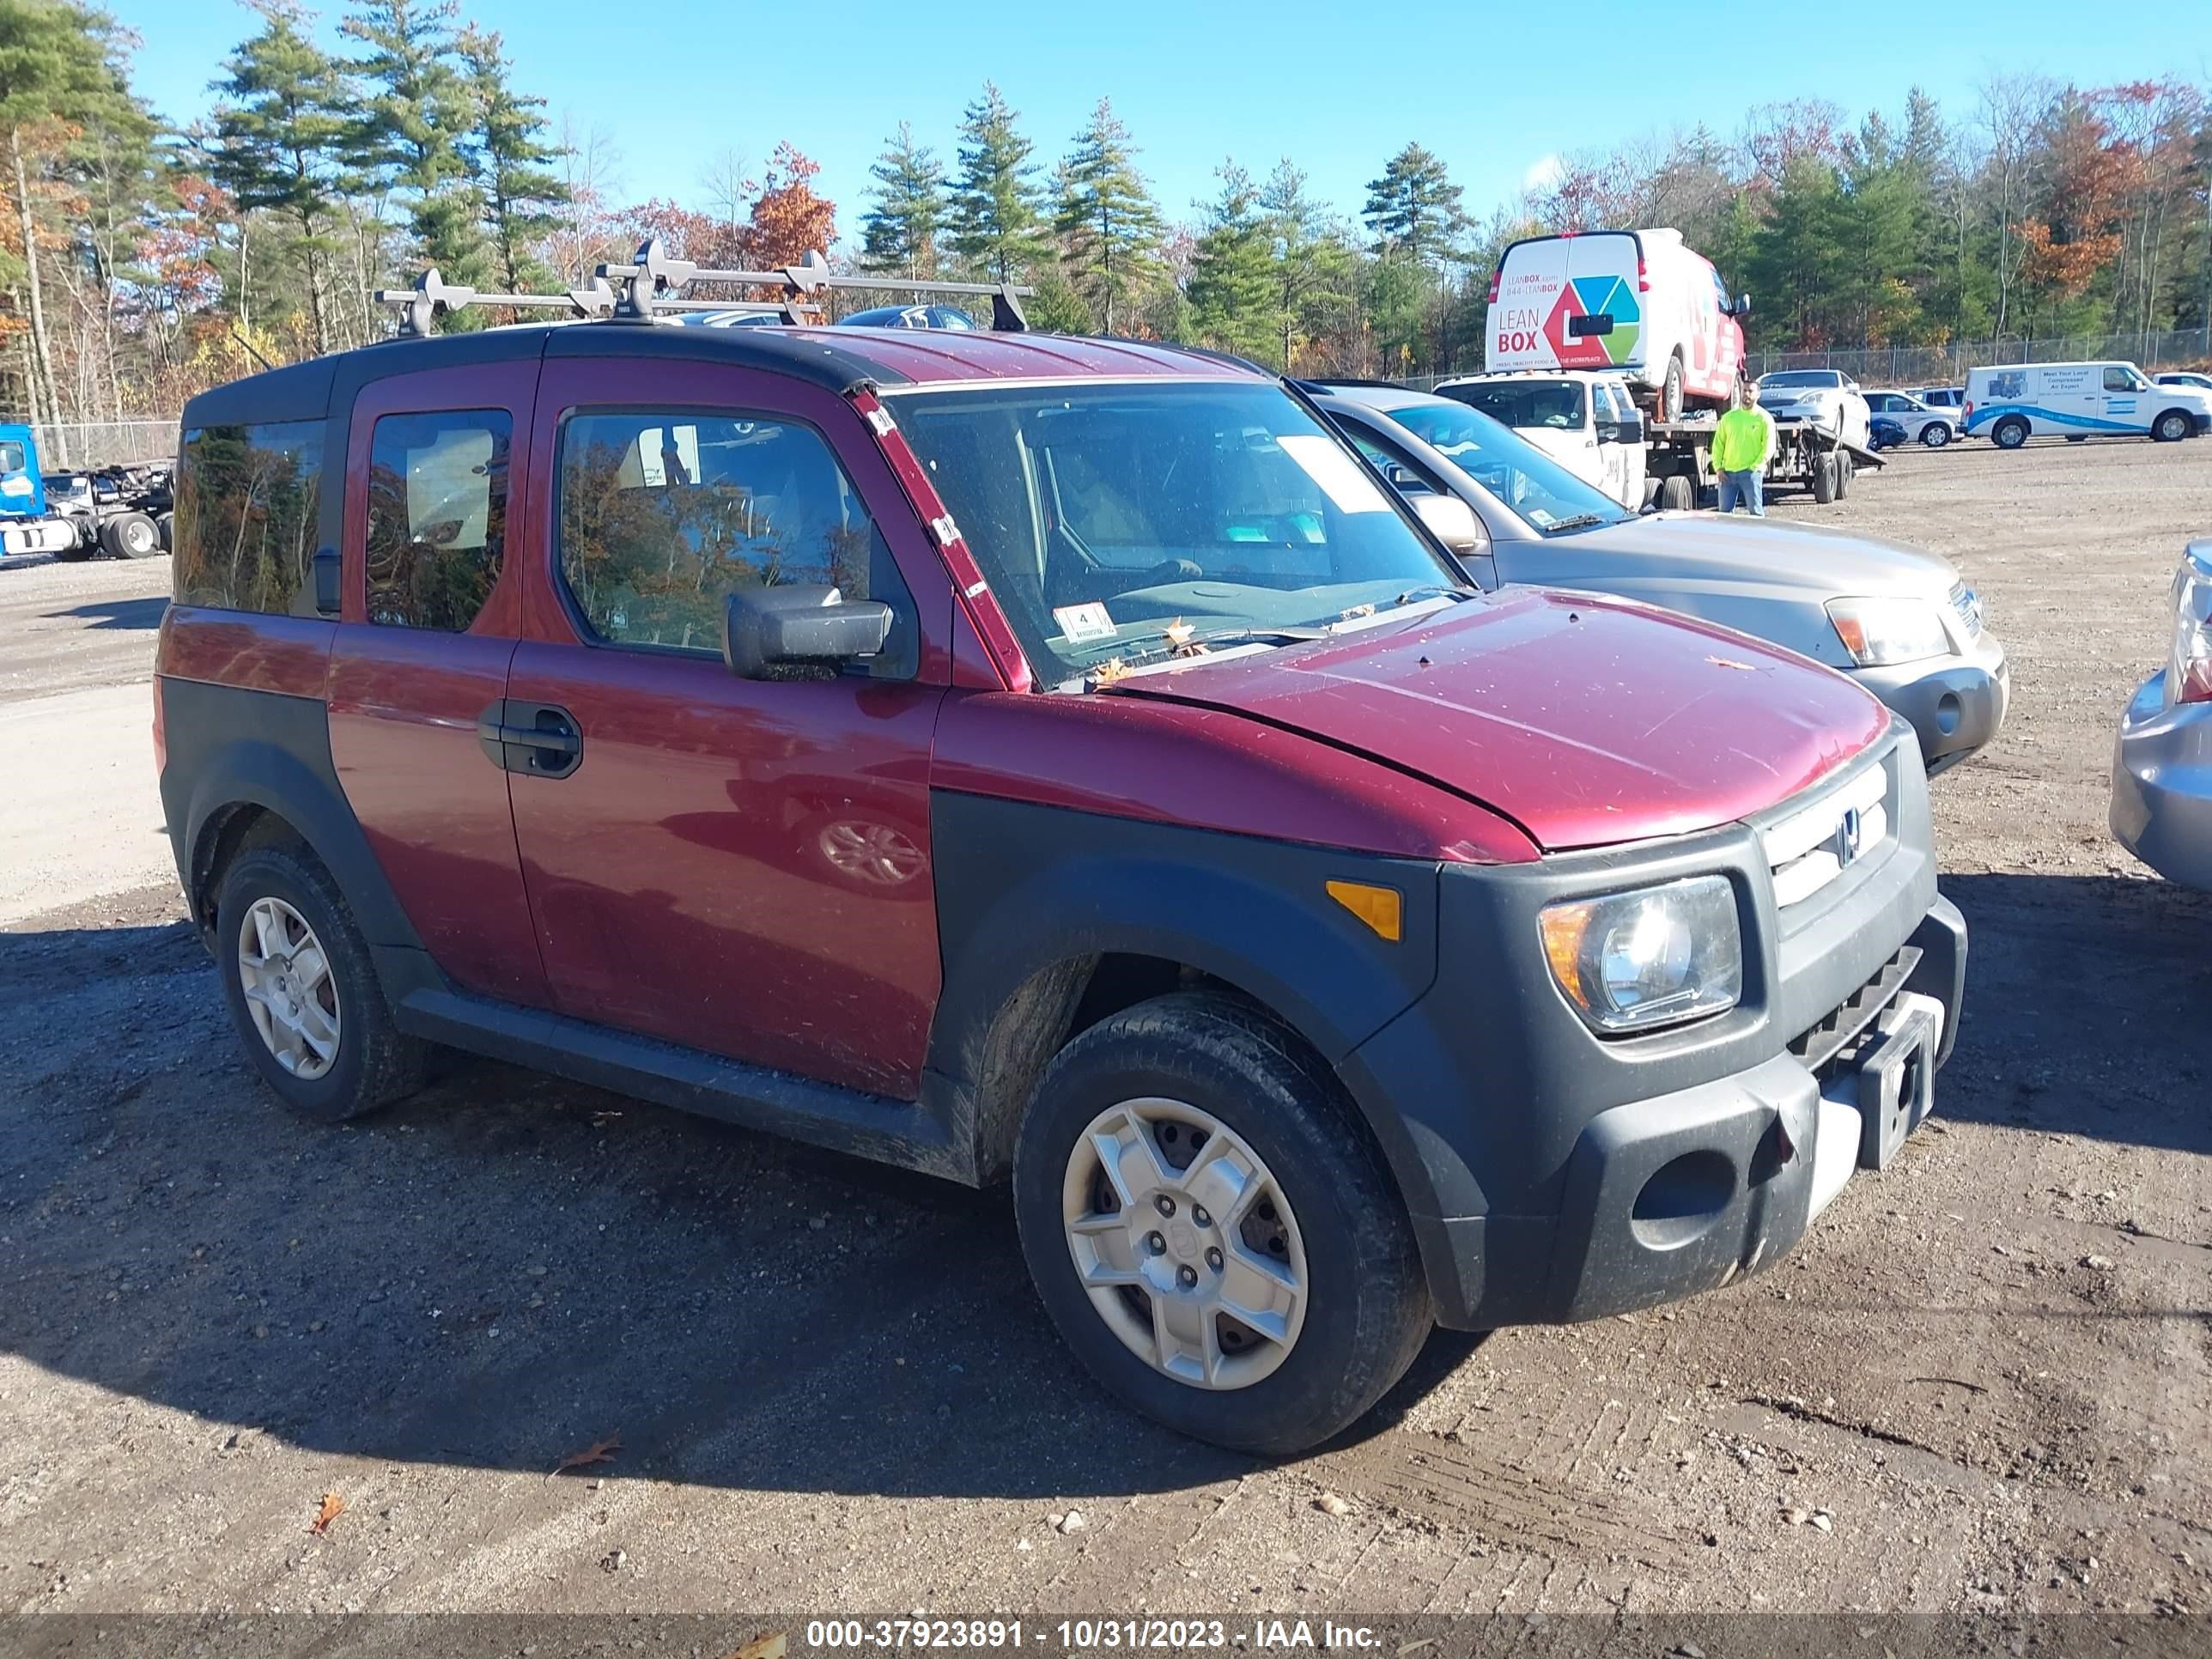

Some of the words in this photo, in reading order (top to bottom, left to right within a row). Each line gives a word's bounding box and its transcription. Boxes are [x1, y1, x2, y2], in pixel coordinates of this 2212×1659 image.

[1508, 274, 1559, 286] LEANBOX.com
[1499, 307, 1540, 331] LEAN
[1498, 331, 1538, 353] BOX
[1080, 613, 1088, 623] 4
